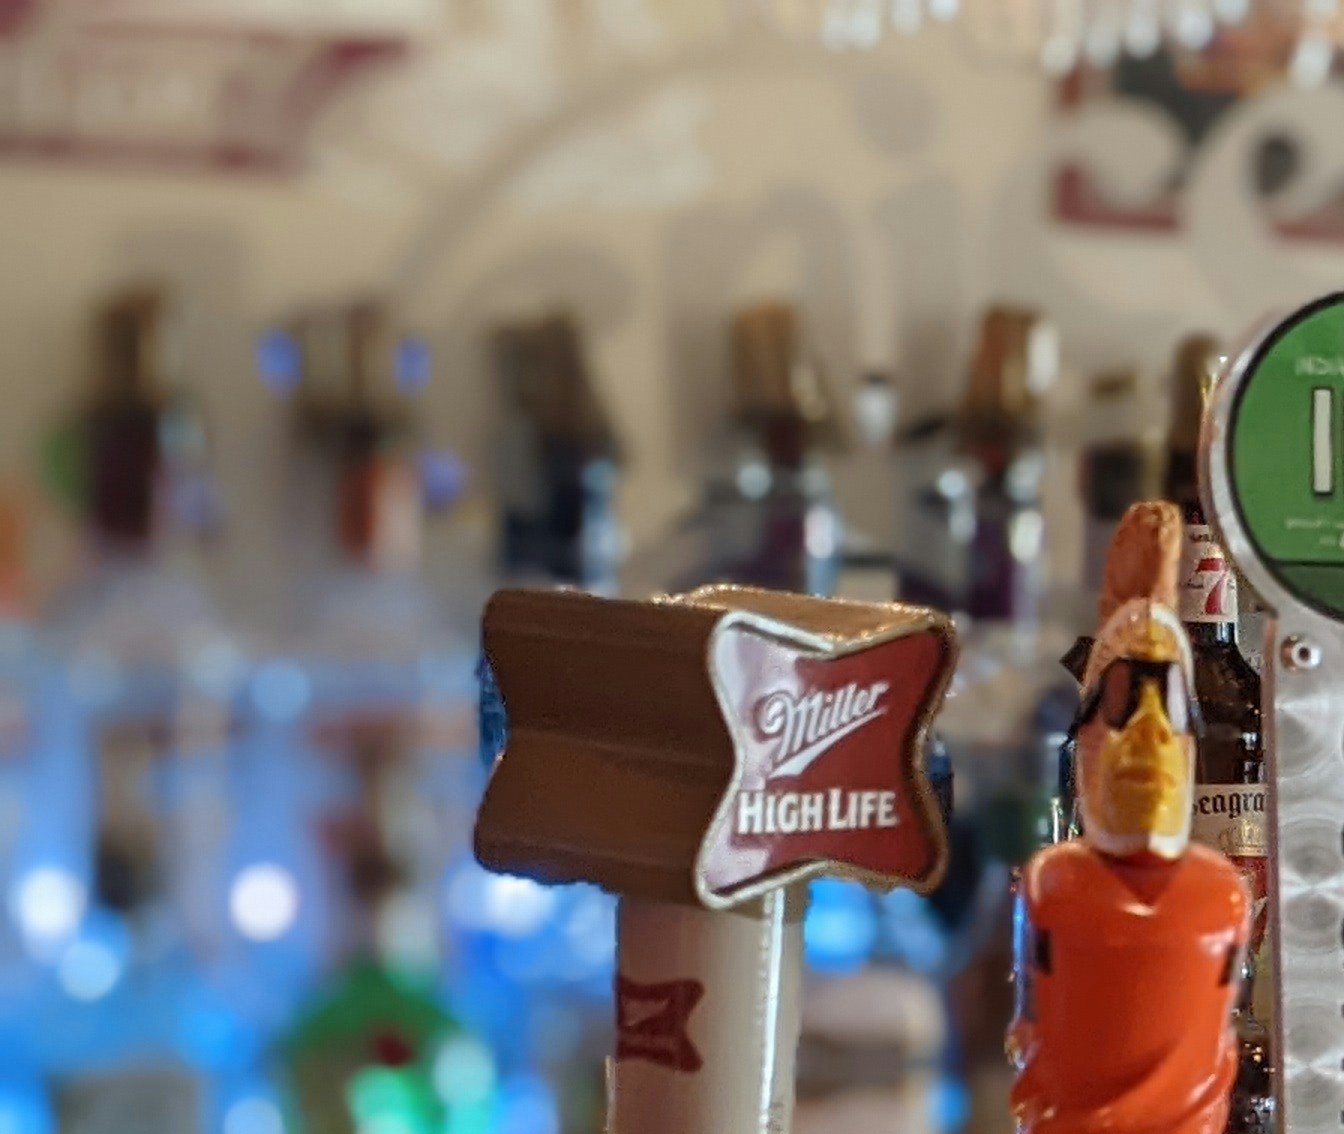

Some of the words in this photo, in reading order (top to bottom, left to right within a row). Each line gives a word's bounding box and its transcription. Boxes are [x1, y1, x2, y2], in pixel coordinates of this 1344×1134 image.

[761, 681, 890, 765] Miller
[738, 791, 823, 834] HIGH
[828, 788, 898, 830] LIFE
